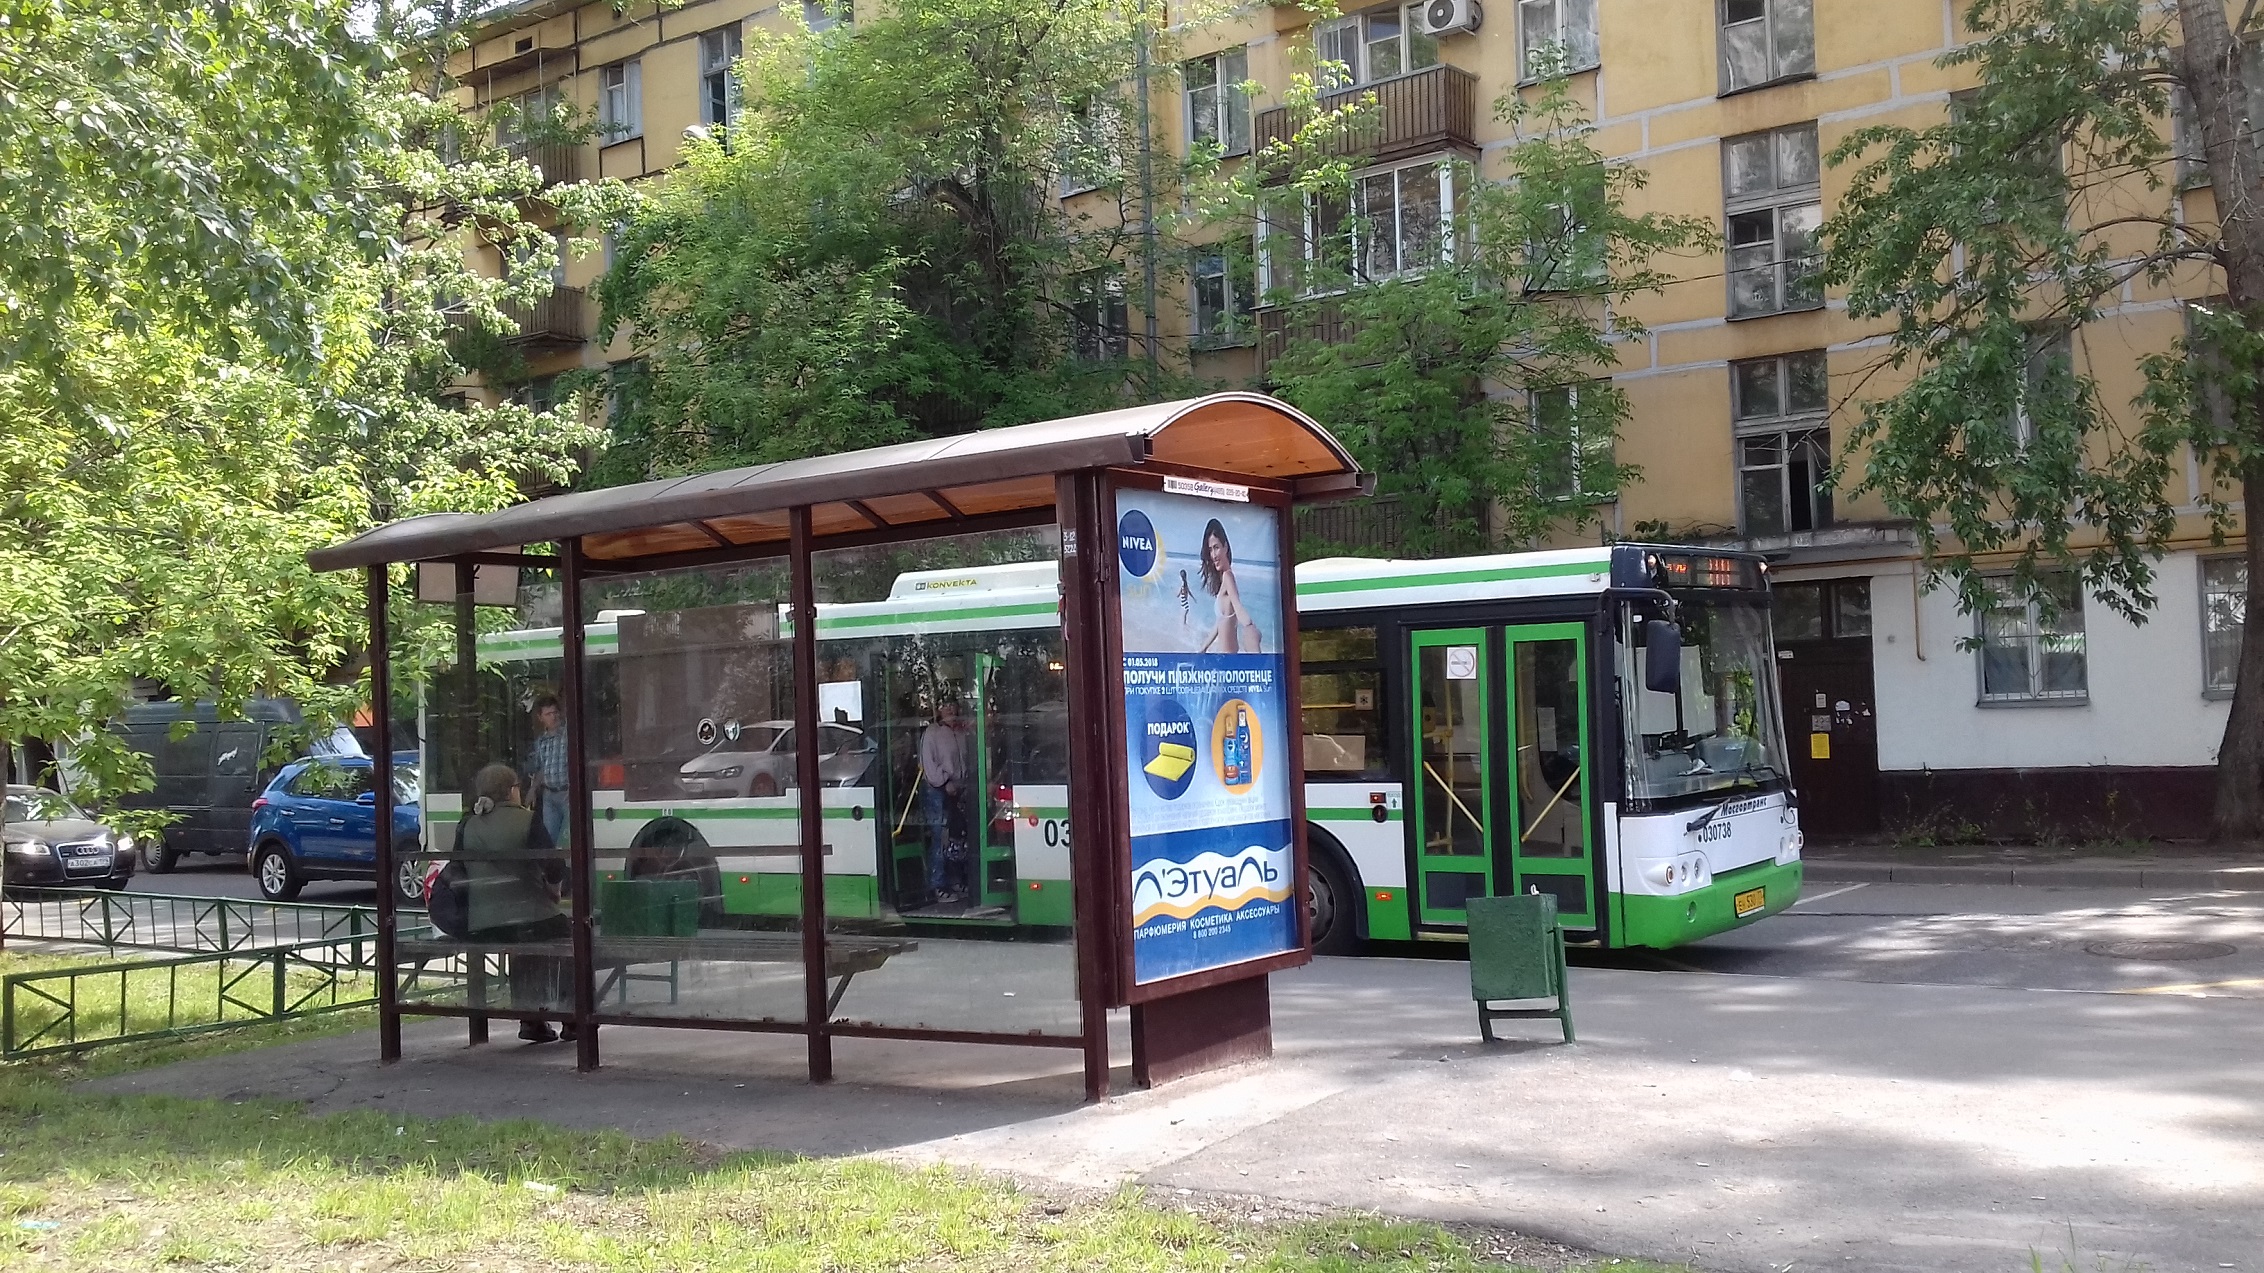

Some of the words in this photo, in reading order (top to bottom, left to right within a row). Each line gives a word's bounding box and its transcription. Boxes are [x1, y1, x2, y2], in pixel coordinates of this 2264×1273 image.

[1122, 536, 1153, 551] NIVEA
[927, 579, 977, 589] KONVEKTA
[1123, 670, 1166, 684] ПОЛУЧИ
[1168, 670, 1217, 684] ПЛЯЖНОЕ
[1219, 669, 1273, 685] ПОЛОТЕНЦЕ
[1147, 722, 1190, 737] ПОДАРОК
[1720, 797, 1767, 817] Мосгортранс
[1702, 821, 1732, 843] 030738
[1134, 921, 1187, 940] ПАРФЮМЕРИЯ
[1190, 912, 1233, 930] КОСМЕТИКА
[1235, 904, 1280, 921] АКСЕССУАРЫ
